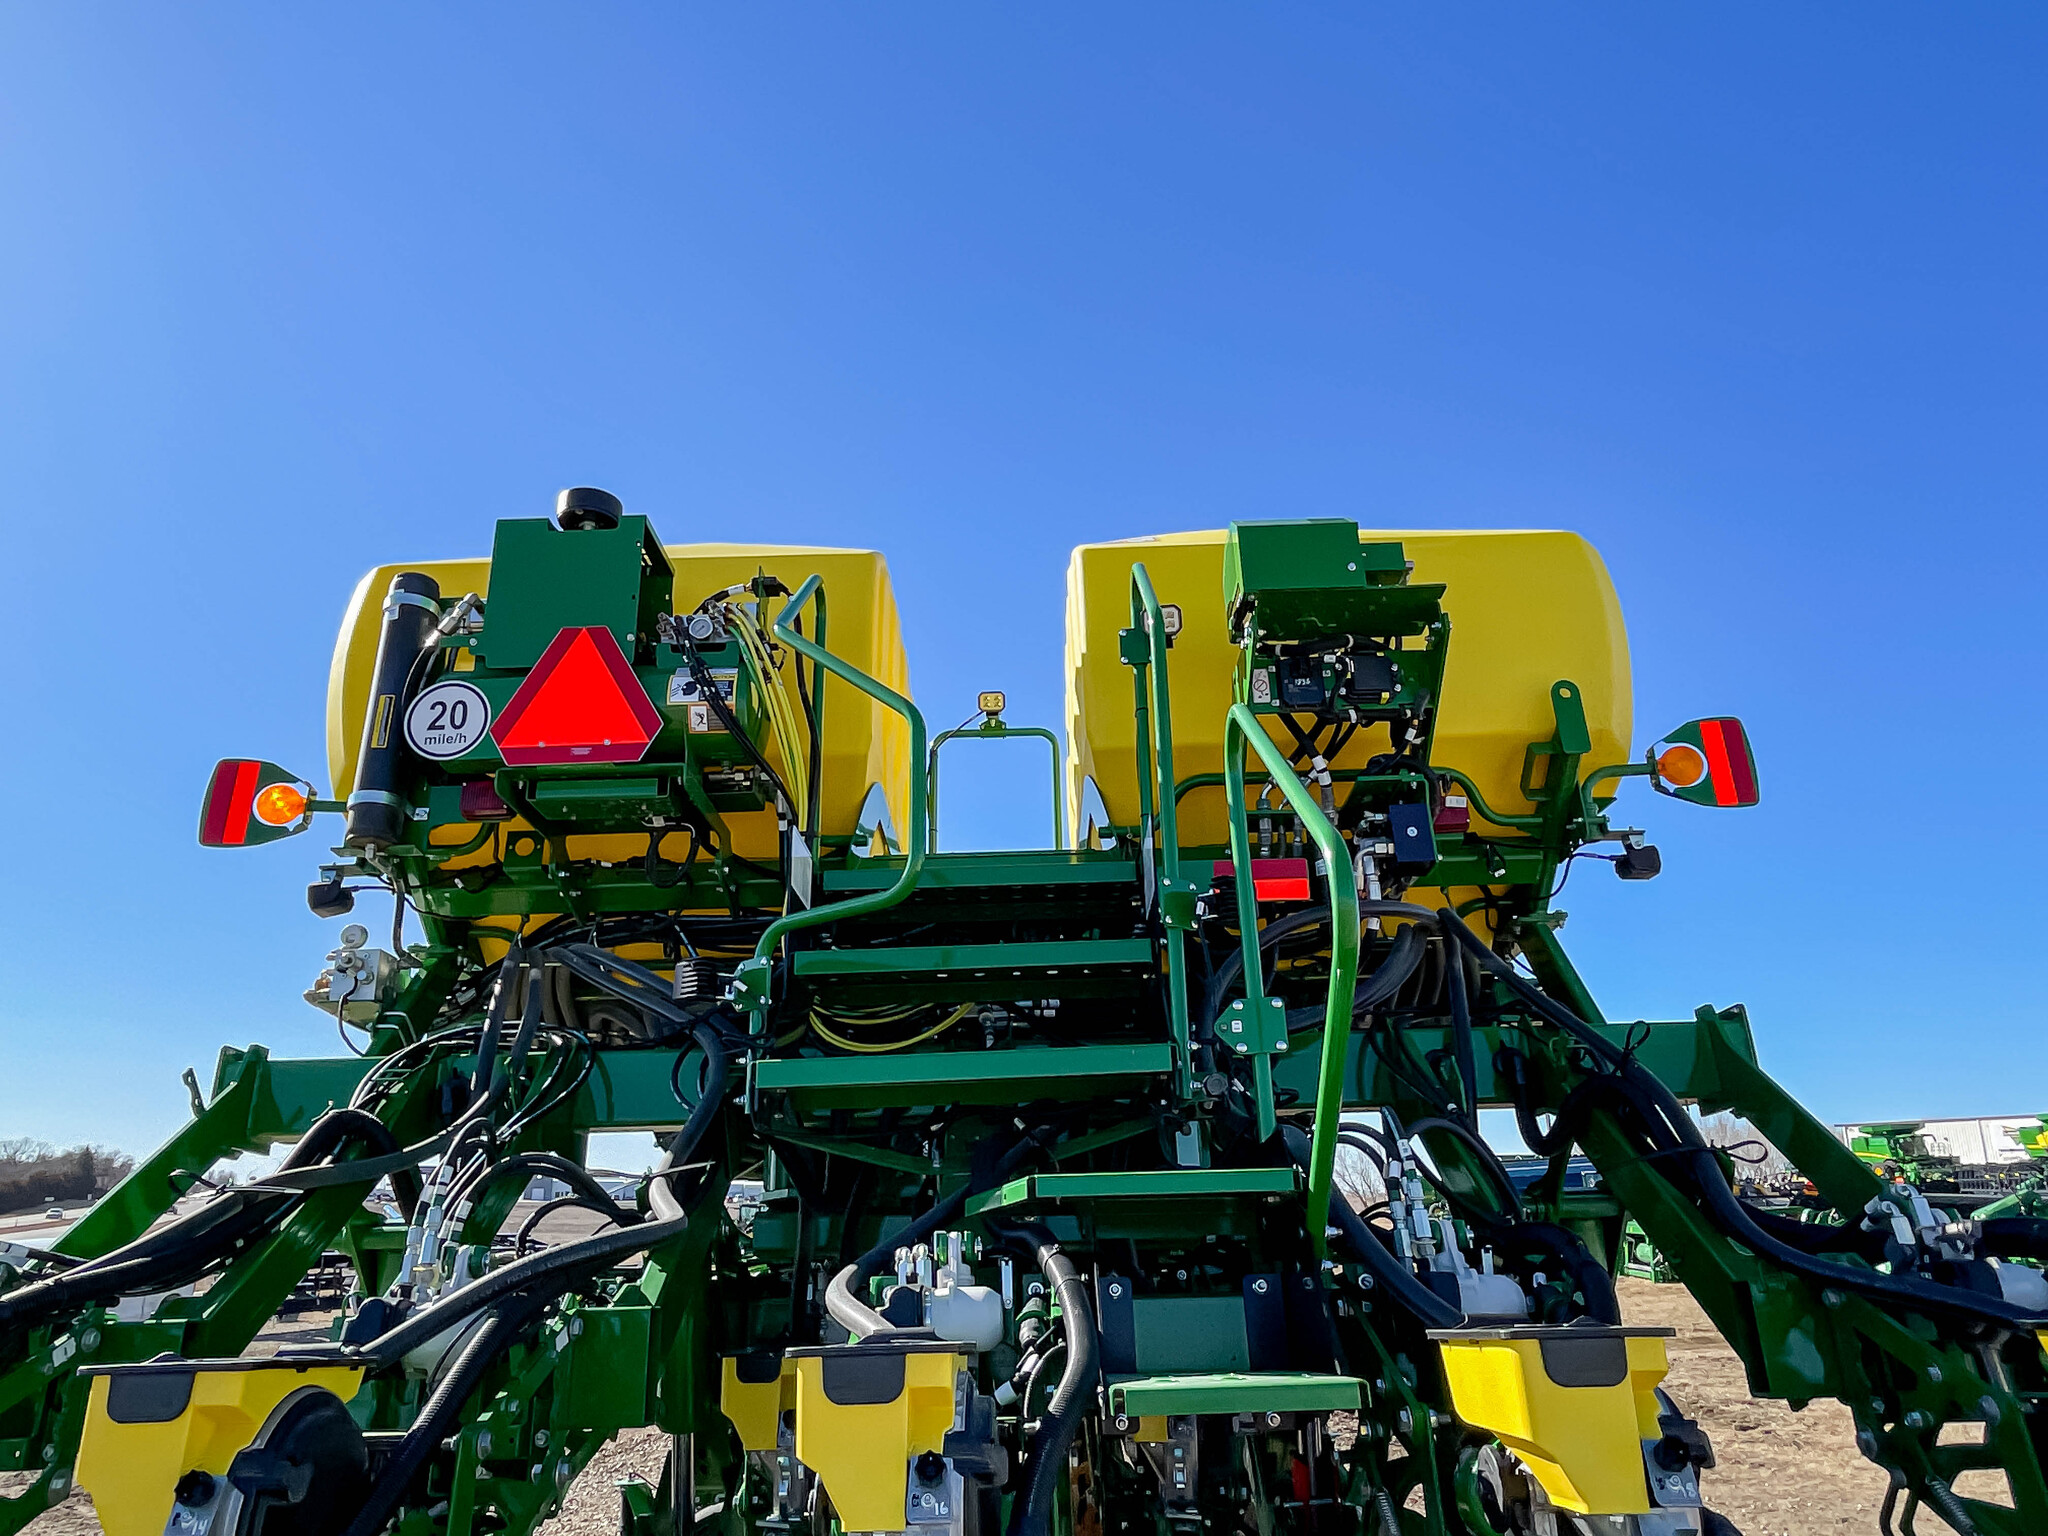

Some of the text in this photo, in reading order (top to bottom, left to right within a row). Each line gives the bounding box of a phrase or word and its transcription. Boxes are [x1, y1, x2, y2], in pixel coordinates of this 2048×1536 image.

[427, 700, 468, 731] 20
[424, 733, 467, 745] mile/h
[934, 1502, 949, 1516] 16
